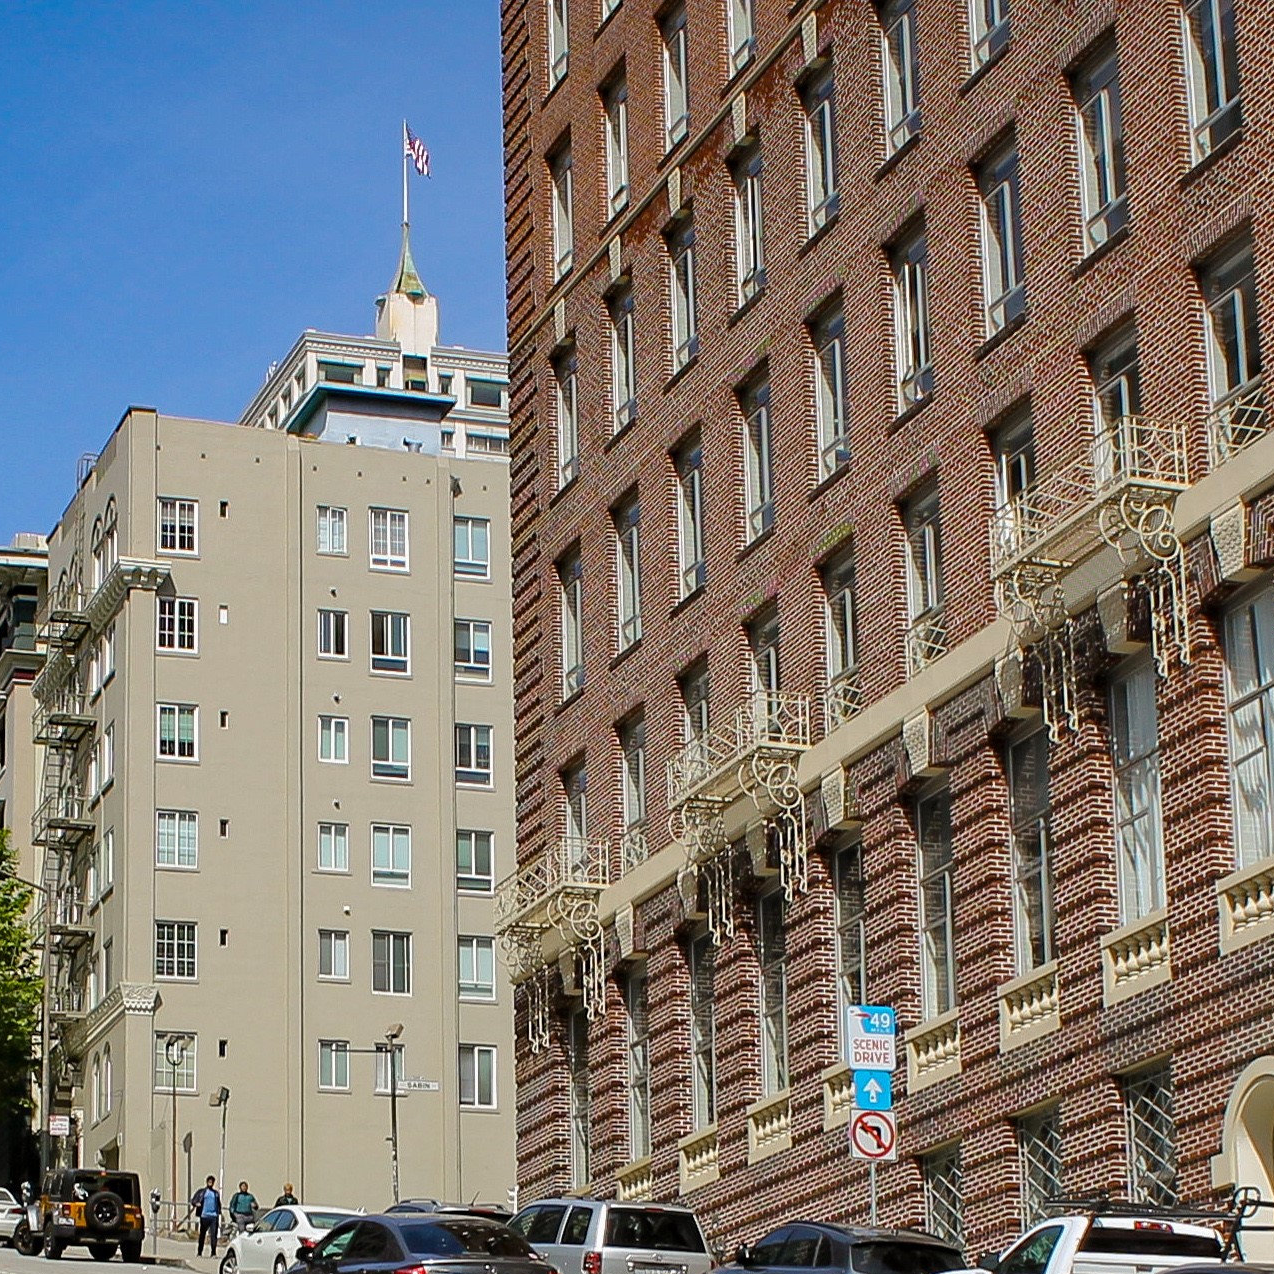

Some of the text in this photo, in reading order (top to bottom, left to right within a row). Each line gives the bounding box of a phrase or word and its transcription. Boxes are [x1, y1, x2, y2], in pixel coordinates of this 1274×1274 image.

[870, 1012, 890, 1028] 49
[853, 1038, 890, 1051] SCENIC
[854, 1051, 890, 1063] DRIVE
[407, 1081, 431, 1089] SABIN
